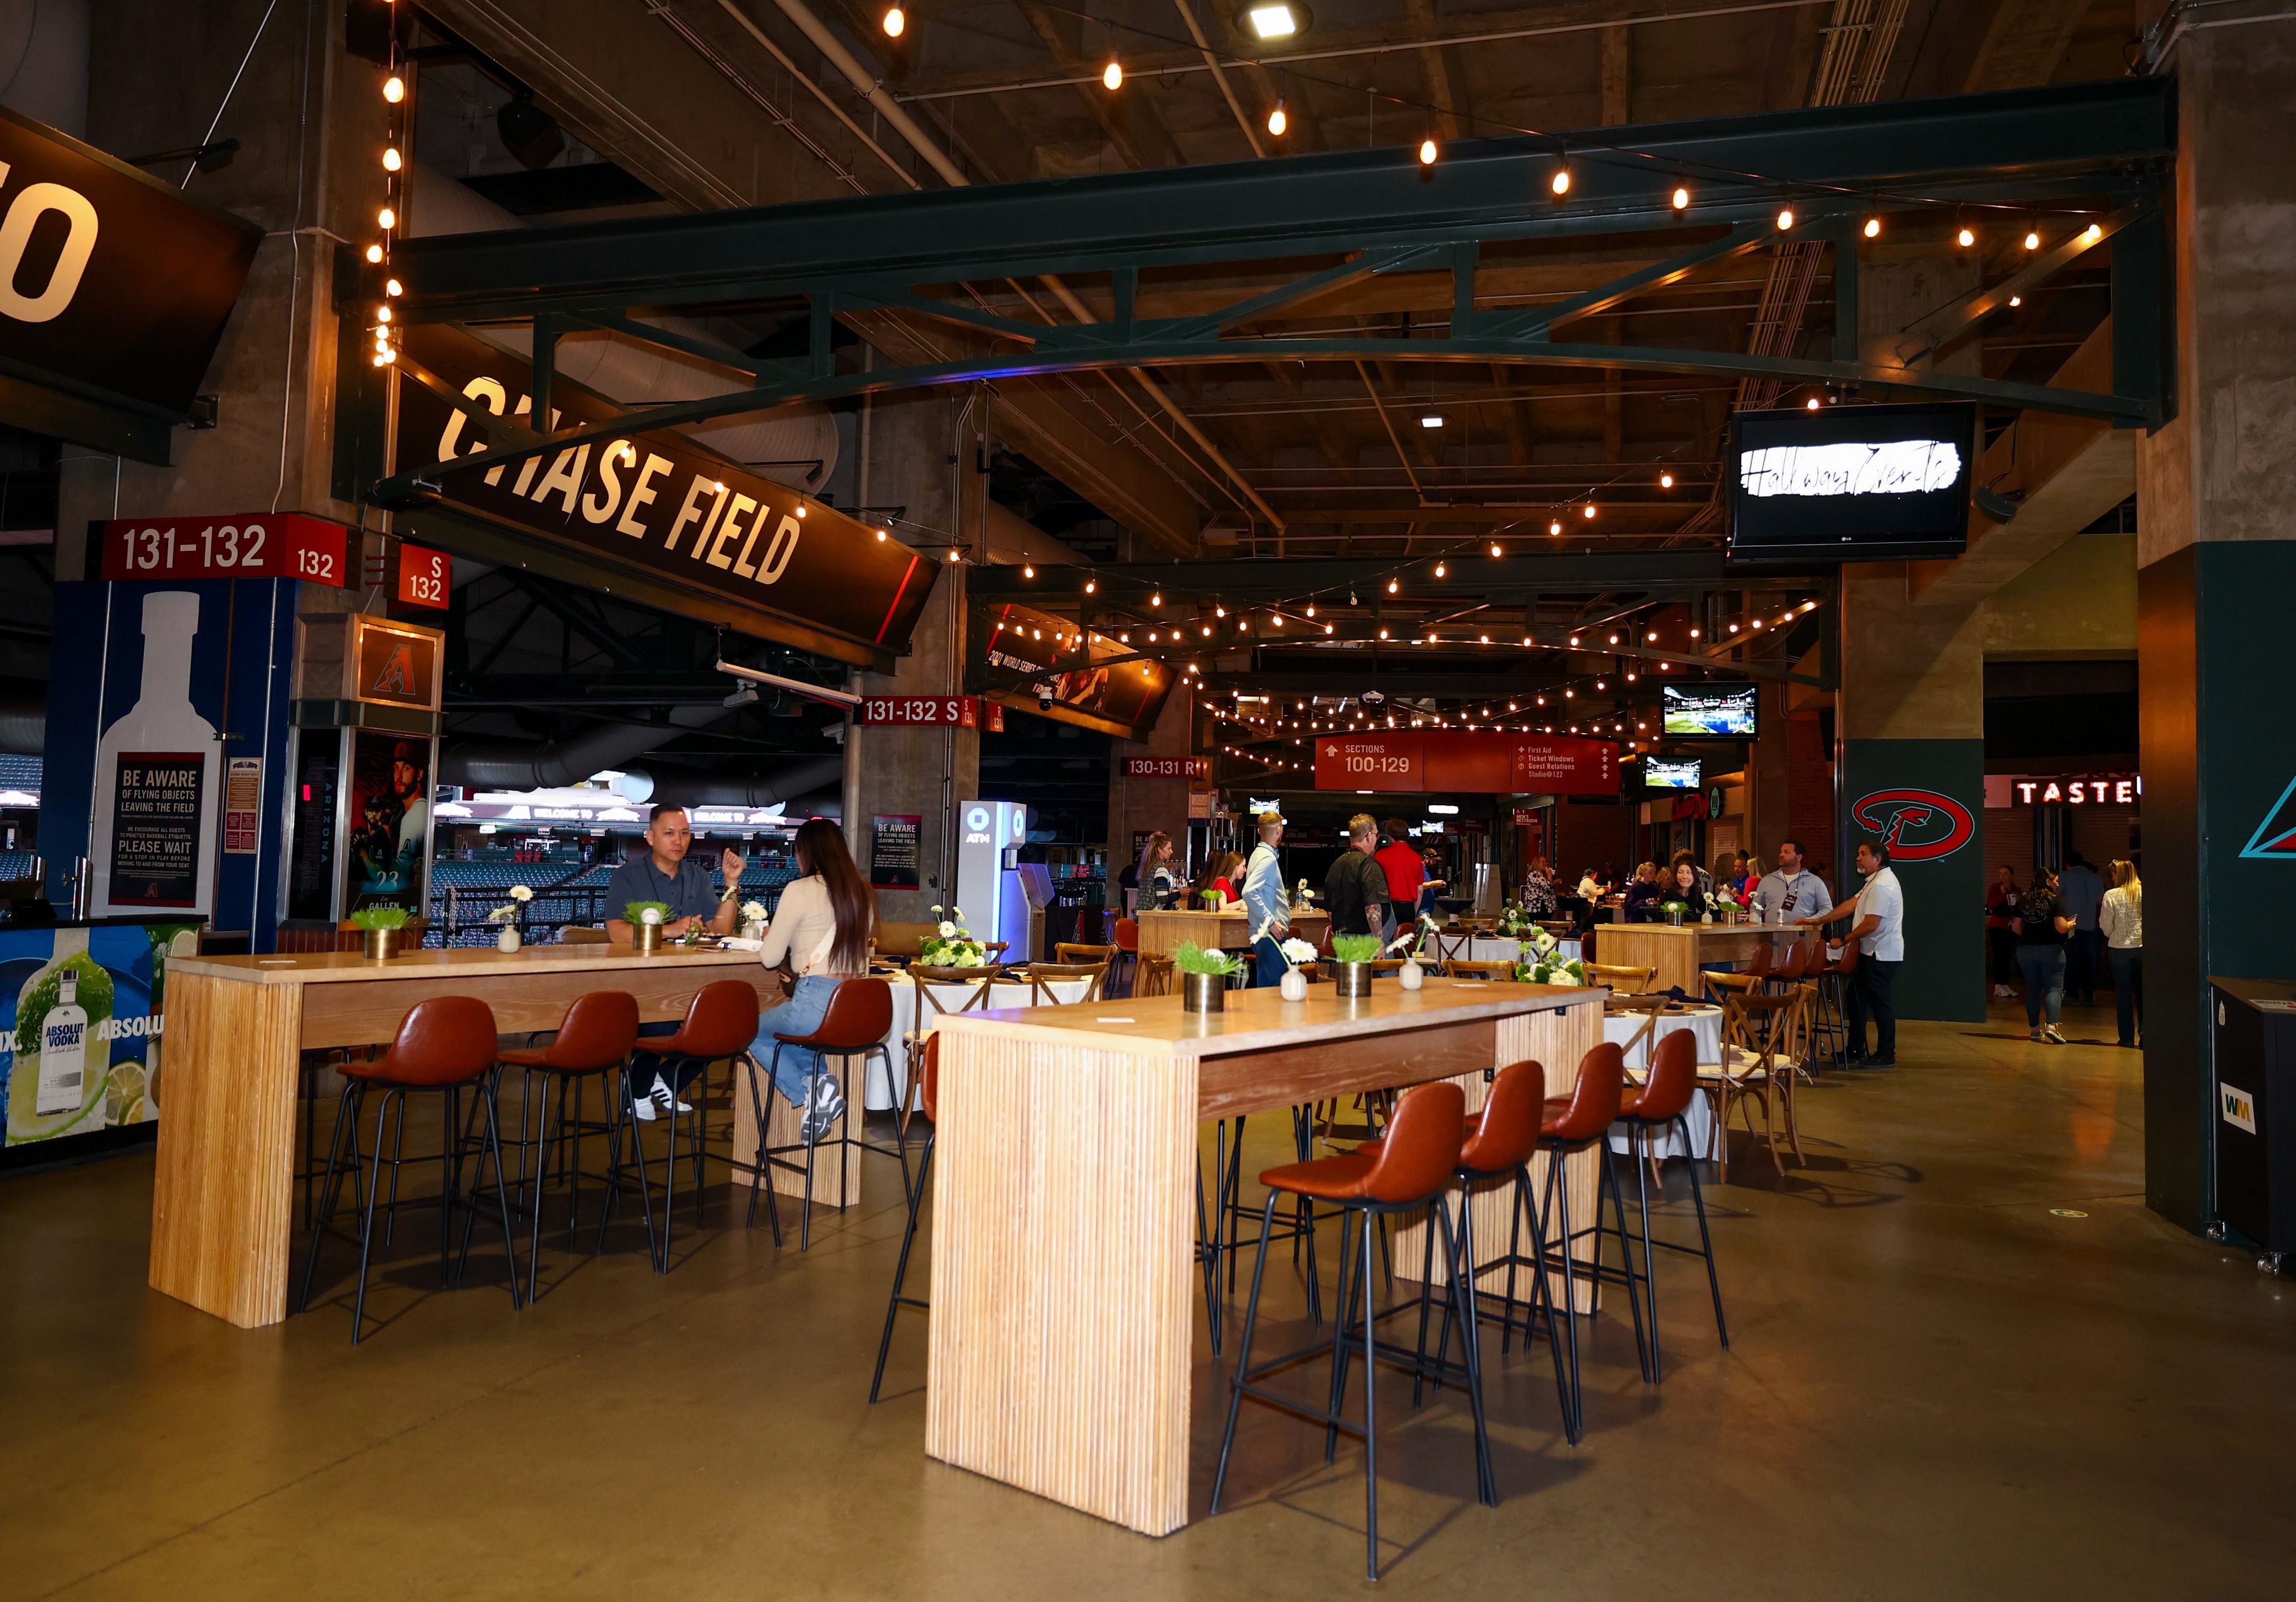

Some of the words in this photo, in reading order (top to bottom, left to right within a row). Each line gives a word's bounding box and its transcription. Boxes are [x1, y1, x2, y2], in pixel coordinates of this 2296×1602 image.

[0, 160, 99, 323] O
[1741, 445, 1849, 497] Hallway
[664, 474, 800, 585] FIELD
[123, 524, 266, 570] 131-132
[298, 548, 333, 579] 132
[431, 557, 442, 577] S
[410, 574, 441, 601] 132
[1003, 654, 1021, 670] WORLD
[1019, 660, 1037, 674] SERIES
[866, 701, 936, 722] 131-132
[946, 701, 958, 722] S
[964, 699, 969, 711] S
[997, 705, 1002, 717] R
[964, 711, 973, 724] 131
[994, 717, 1003, 729] 131
[1345, 744, 1385, 754] SECTIONS
[1130, 760, 1179, 775] 130-131
[1185, 760, 1195, 775] R
[1345, 756, 1410, 774] 100-129
[123, 769, 141, 787] BE
[145, 770, 197, 788] AWARE
[122, 789, 132, 799] OF
[134, 790, 160, 799] FLYING
[162, 790, 195, 800] OBJECTS
[2017, 781, 2133, 804] TASTE
[121, 802, 154, 812] LEAVING
[156, 802, 171, 812] THE
[173, 803, 194, 813] FIELD
[534, 808, 579, 819] WELCOME
[581, 809, 593, 819] TO
[320, 782, 332, 863] ARIZONA
[694, 811, 732, 822] WELCOME
[733, 812, 745, 822] TO
[890, 824, 916, 833] AWARE
[966, 834, 990, 843] ATM
[119, 840, 161, 853] PLEASE
[164, 841, 191, 854] WAIT
[376, 871, 399, 890] 23
[369, 901, 399, 910] GALLEN
[46, 1023, 84, 1038] ABSOLUT
[97, 1014, 164, 1041] ABSOLU
[48, 1034, 80, 1047] VODKA
